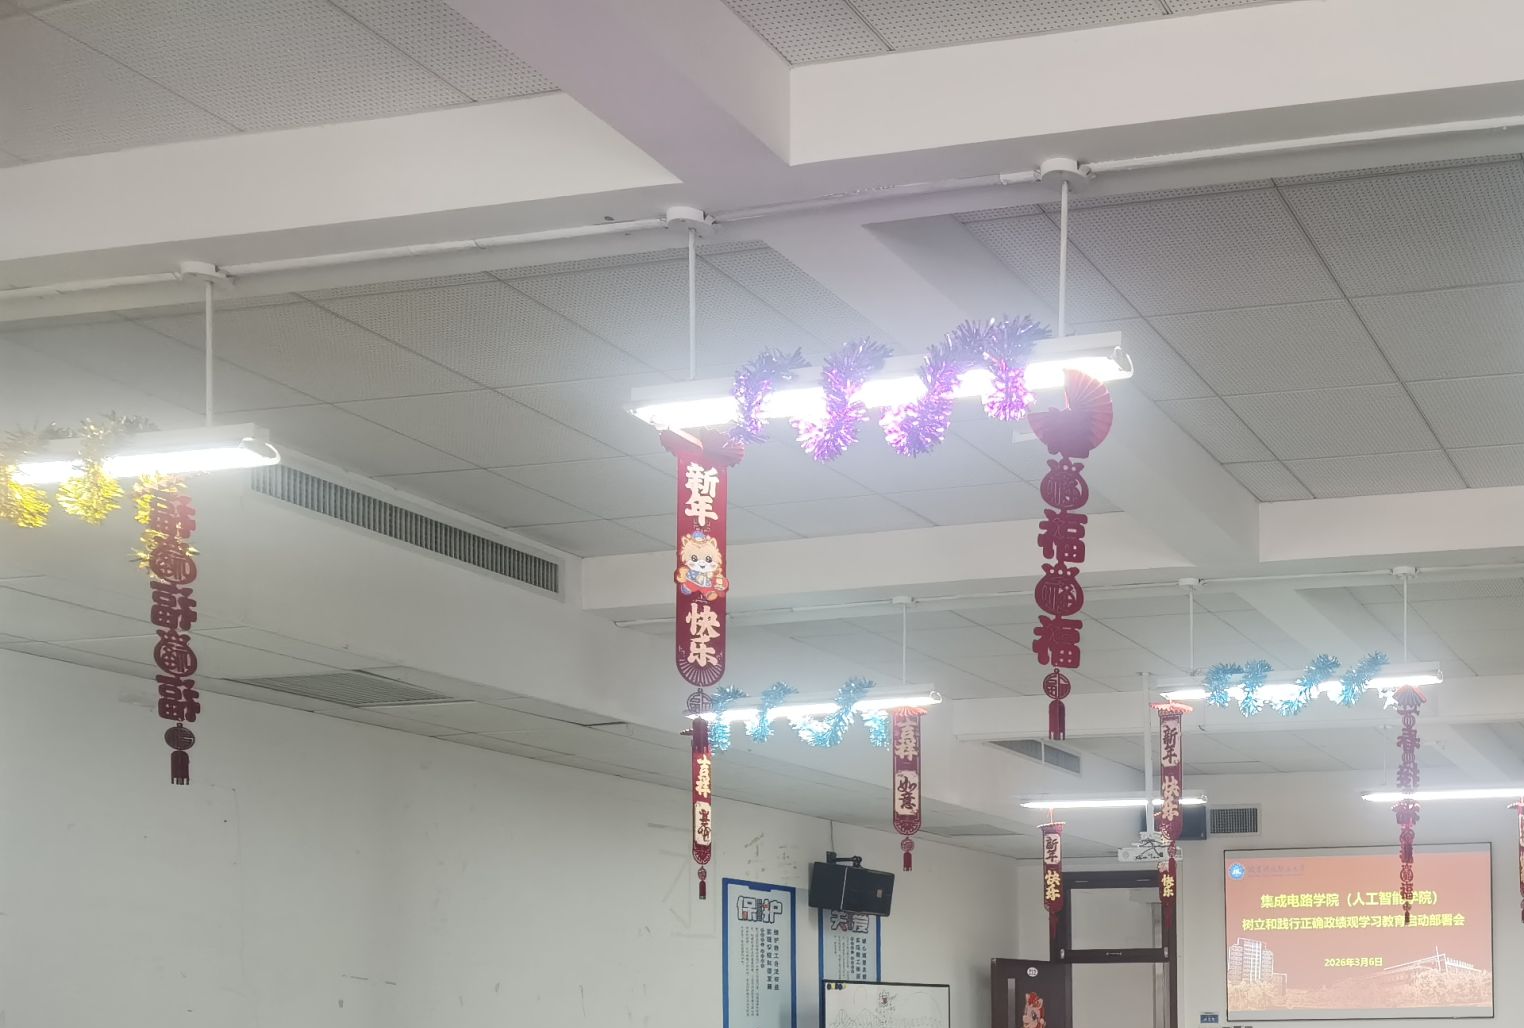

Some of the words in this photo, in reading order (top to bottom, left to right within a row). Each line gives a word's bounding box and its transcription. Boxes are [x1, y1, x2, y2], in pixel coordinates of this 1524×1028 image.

[737, 896, 783, 924] 保护
[1242, 914, 1466, 930] 树立和践行正确政绩观学习教育启动部署会
[1324, 956, 1383, 968] 2026年3月6日
